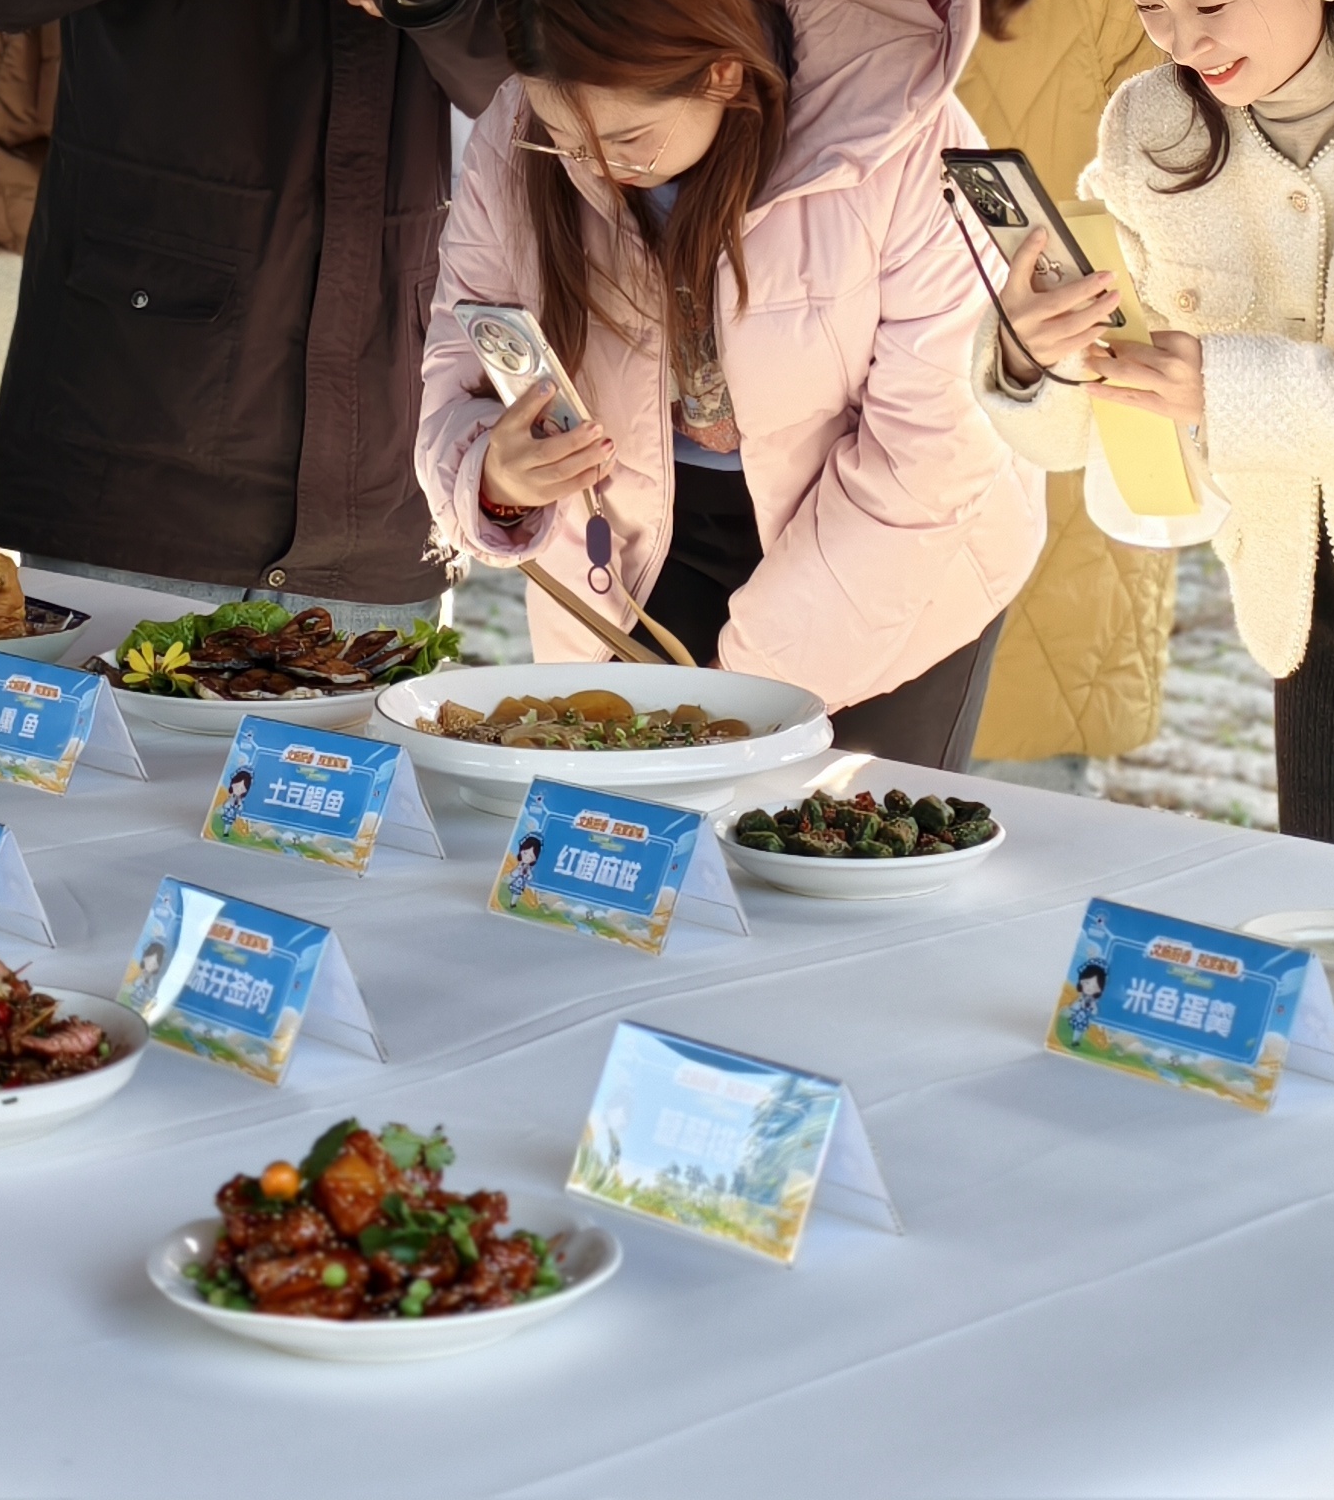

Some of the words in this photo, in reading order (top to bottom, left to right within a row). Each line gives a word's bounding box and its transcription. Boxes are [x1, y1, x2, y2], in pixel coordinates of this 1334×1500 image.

[263, 777, 345, 818] 土豆鲳鱼
[183, 957, 275, 1015] 味牙签肉
